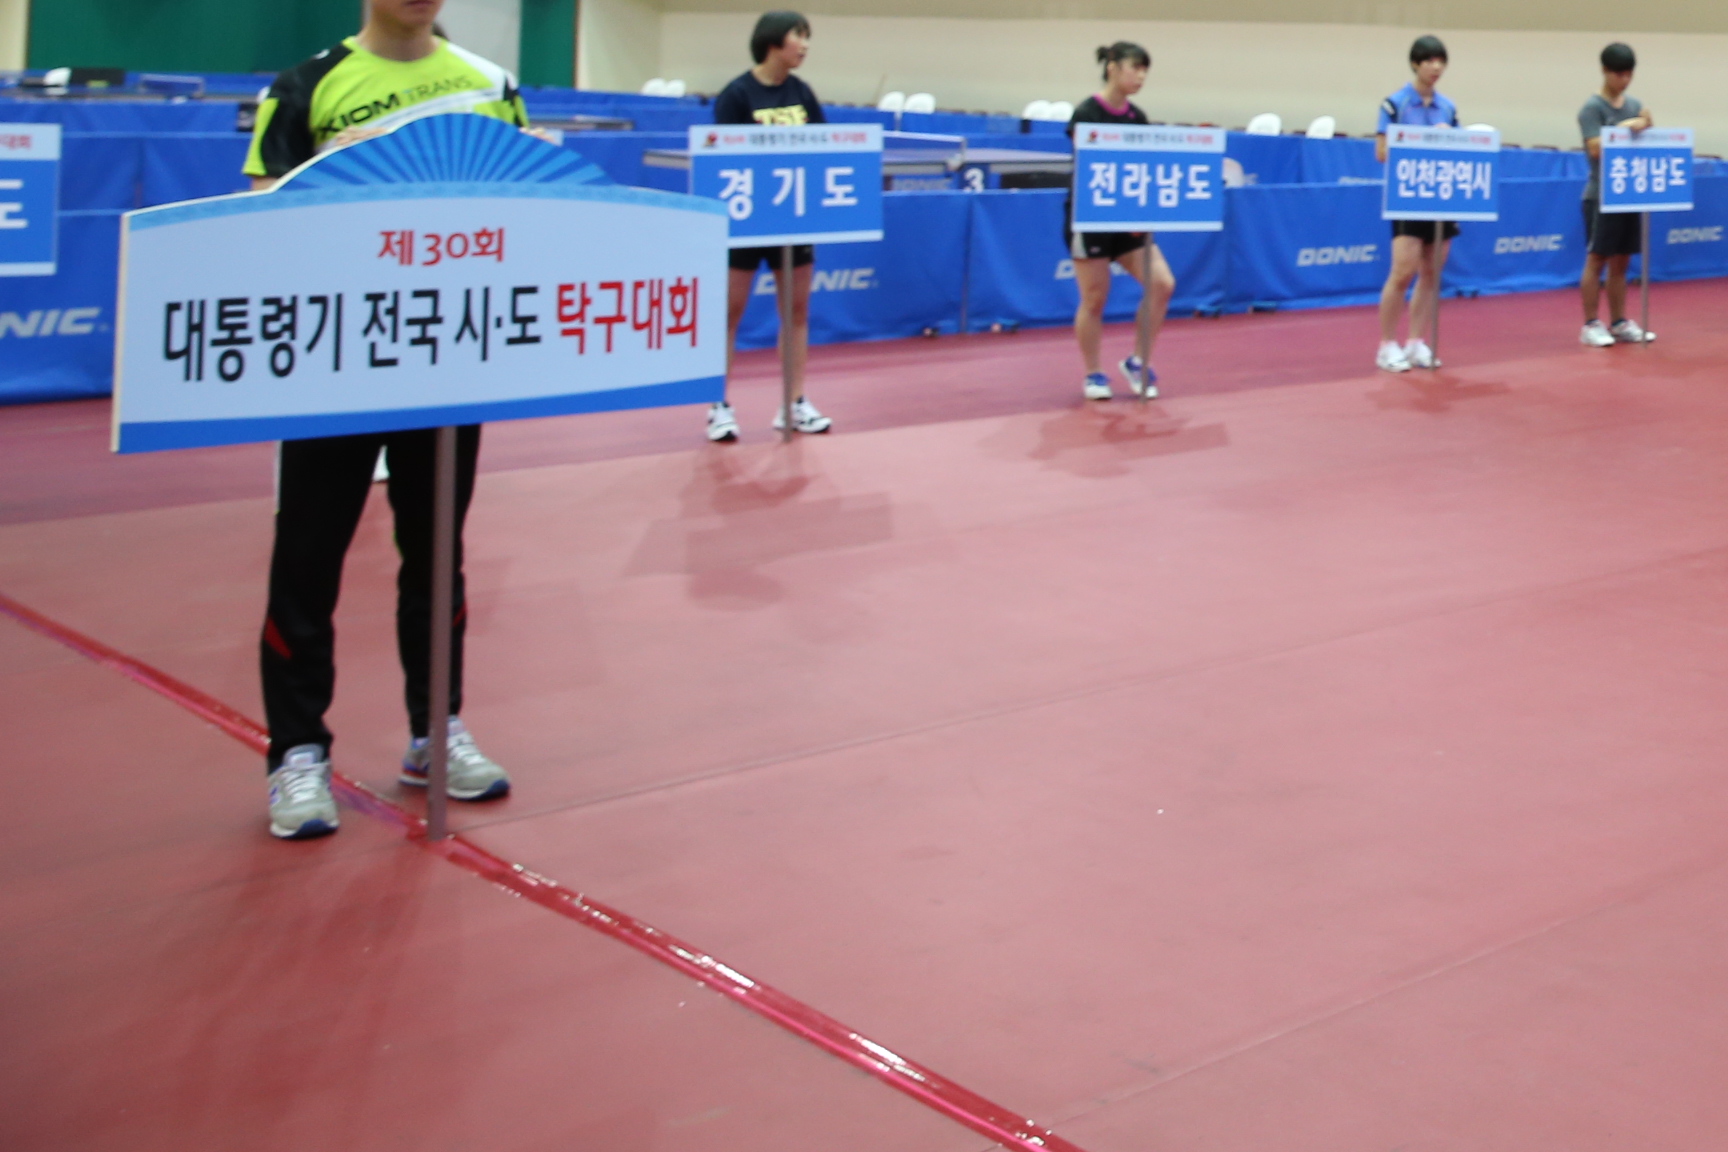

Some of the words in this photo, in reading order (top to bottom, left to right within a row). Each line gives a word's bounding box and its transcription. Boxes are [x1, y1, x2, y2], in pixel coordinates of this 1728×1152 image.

[403, 74, 472, 103] TRANS
[718, 167, 858, 221] 경기도
[963, 167, 986, 193] 3
[1088, 162, 1212, 208] 전라남도
[1396, 159, 1492, 200] 인천광역시
[1609, 154, 1687, 195] 충청남도
[378, 227, 505, 266] 제30회
[1494, 234, 1564, 255] DONIC
[1667, 225, 1724, 245] DONIC
[1296, 244, 1377, 268] DONIC
[163, 293, 343, 382] 대통령기
[362, 288, 443, 369] 전국
[556, 276, 698, 356] 탁구대회
